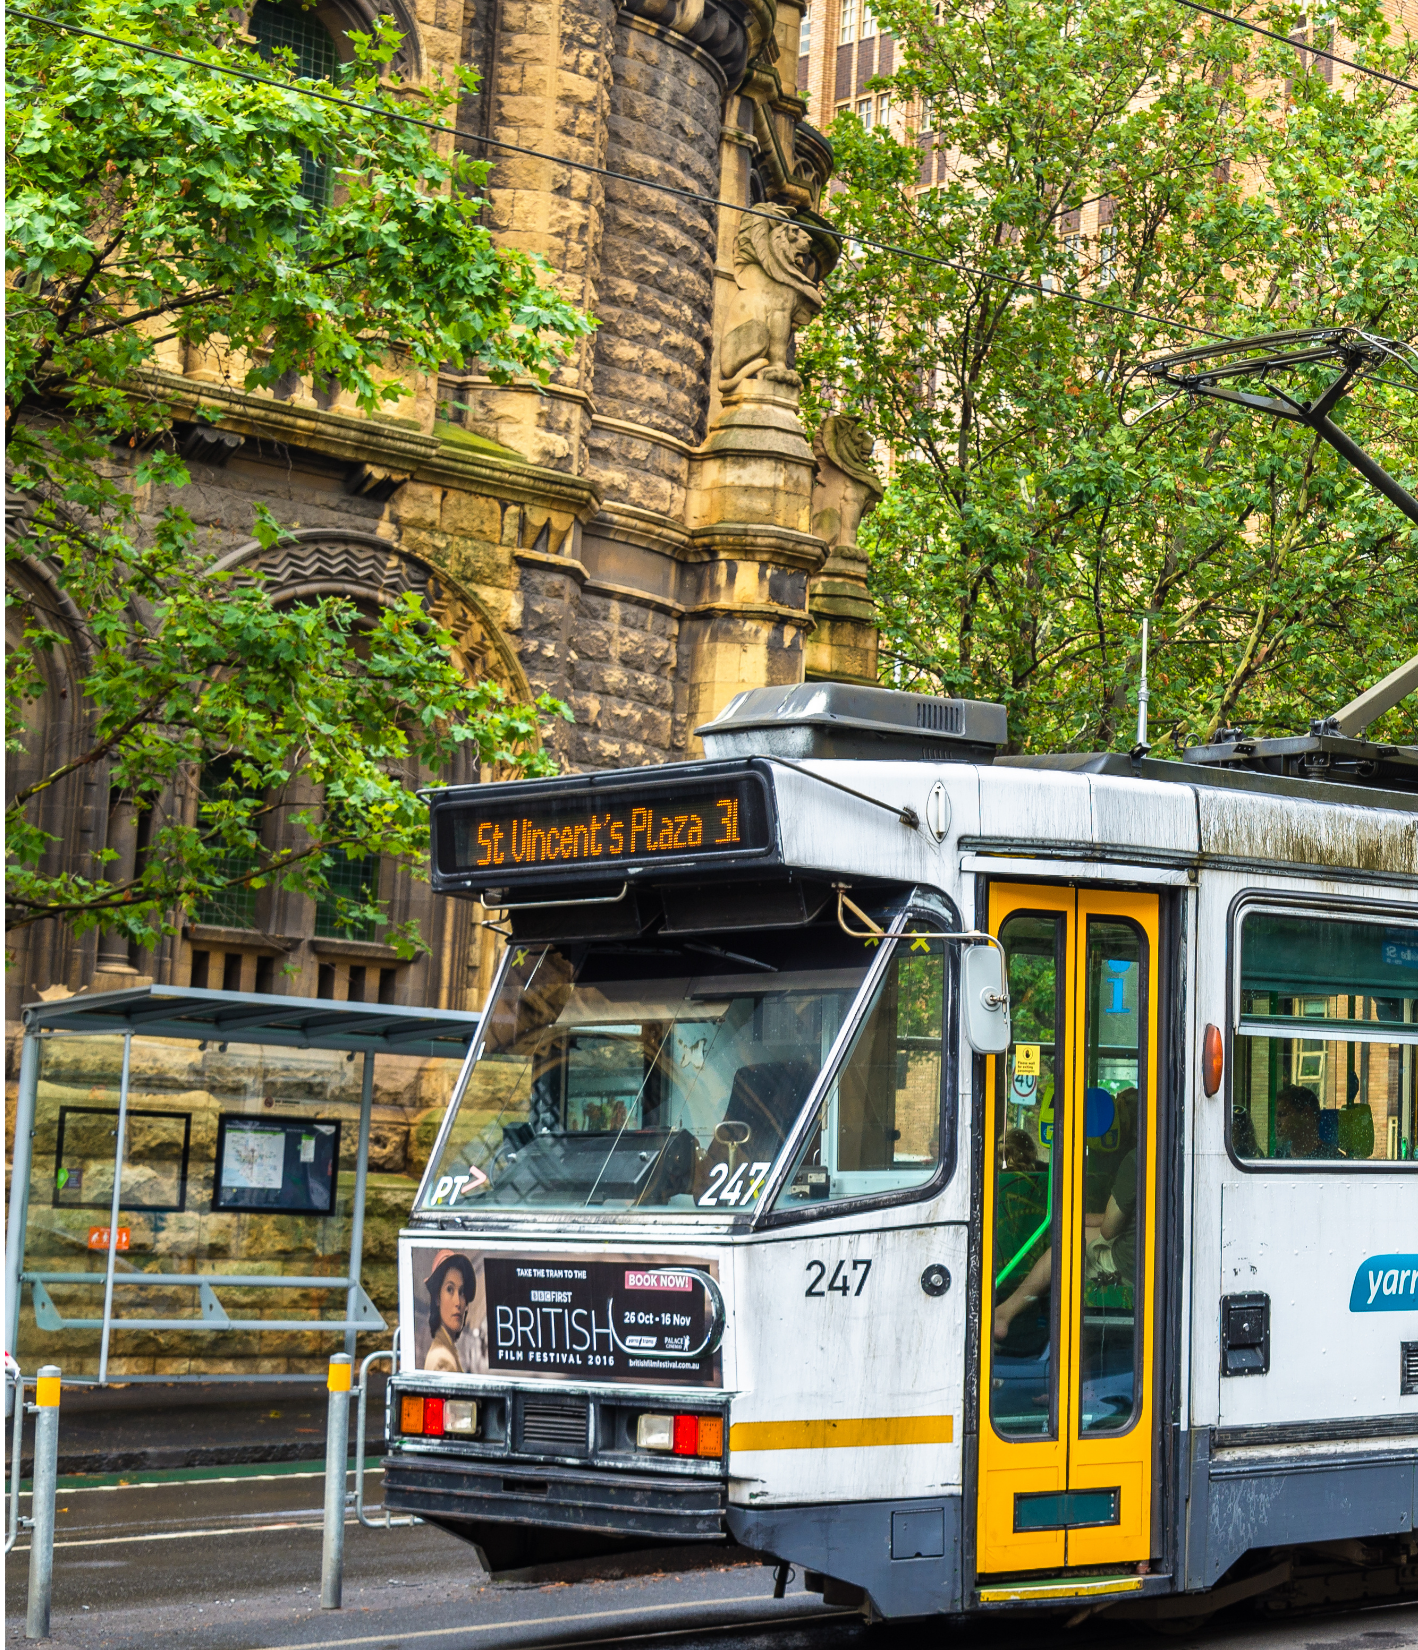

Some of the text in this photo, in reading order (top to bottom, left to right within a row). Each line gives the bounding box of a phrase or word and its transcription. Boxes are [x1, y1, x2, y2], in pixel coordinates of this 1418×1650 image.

[477, 798, 741, 866] St Vincent's Plaza 31
[430, 1175, 469, 1206] PT
[698, 1162, 771, 1207] 247
[516, 1268, 587, 1279] TAKE THE TRAM TO THE
[628, 1273, 689, 1288] BOOK NOW!
[805, 1259, 872, 1297] 247
[531, 1290, 573, 1303] BBC FIRST
[623, 1311, 636, 1323] 26
[637, 1312, 654, 1324] Oct
[661, 1313, 670, 1325] 16
[673, 1314, 691, 1326] Nov
[496, 1305, 614, 1352] BRITISH
[664, 1336, 683, 1345] PALACE
[498, 1350, 615, 1366] FILM FESTIVAL 2016
[629, 1359, 700, 1370] britishfilmfestival.com.au
